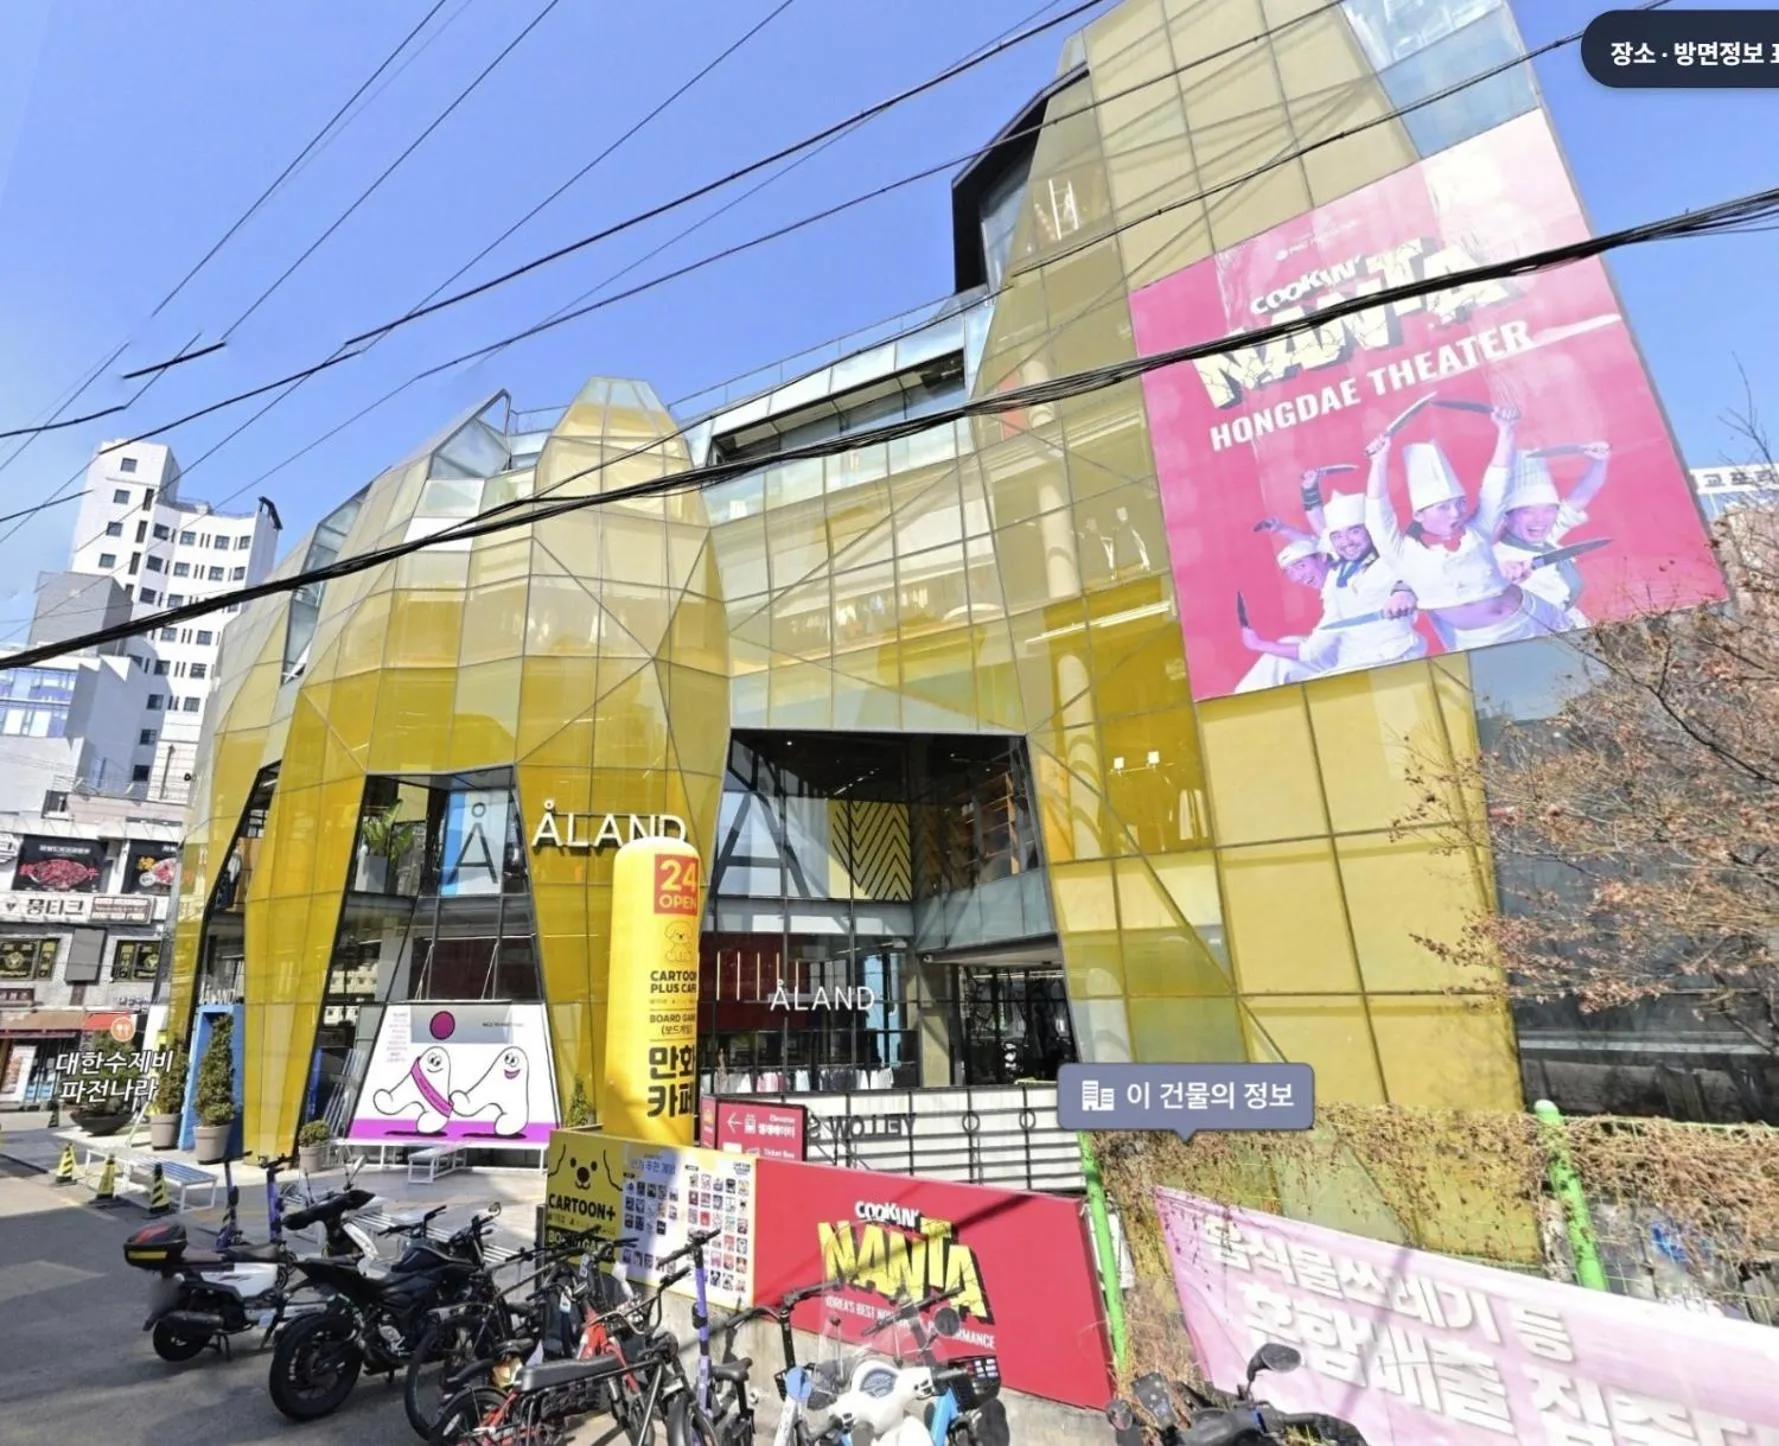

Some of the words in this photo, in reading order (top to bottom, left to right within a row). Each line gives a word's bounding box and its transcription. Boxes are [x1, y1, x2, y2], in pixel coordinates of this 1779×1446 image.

[1251, 254, 1362, 315] COOKIN'
[1194, 237, 1511, 409] NANTA
[1209, 382, 1362, 452] HONGDAE
[1366, 318, 1535, 396] THEATER
[532, 799, 688, 848] ÅLAND
[659, 858, 697, 893] 24
[650, 969, 697, 982] CARTOO
[650, 983, 679, 994] PLUS
[770, 978, 875, 1011] ÅLAND
[649, 1013, 681, 1023] BOARD
[855, 1200, 920, 1228] COOKIN'
[817, 1216, 992, 1323] NANTA
[856, 1302, 875, 1319] BEST
[1511, 1301, 1578, 1364] 등
